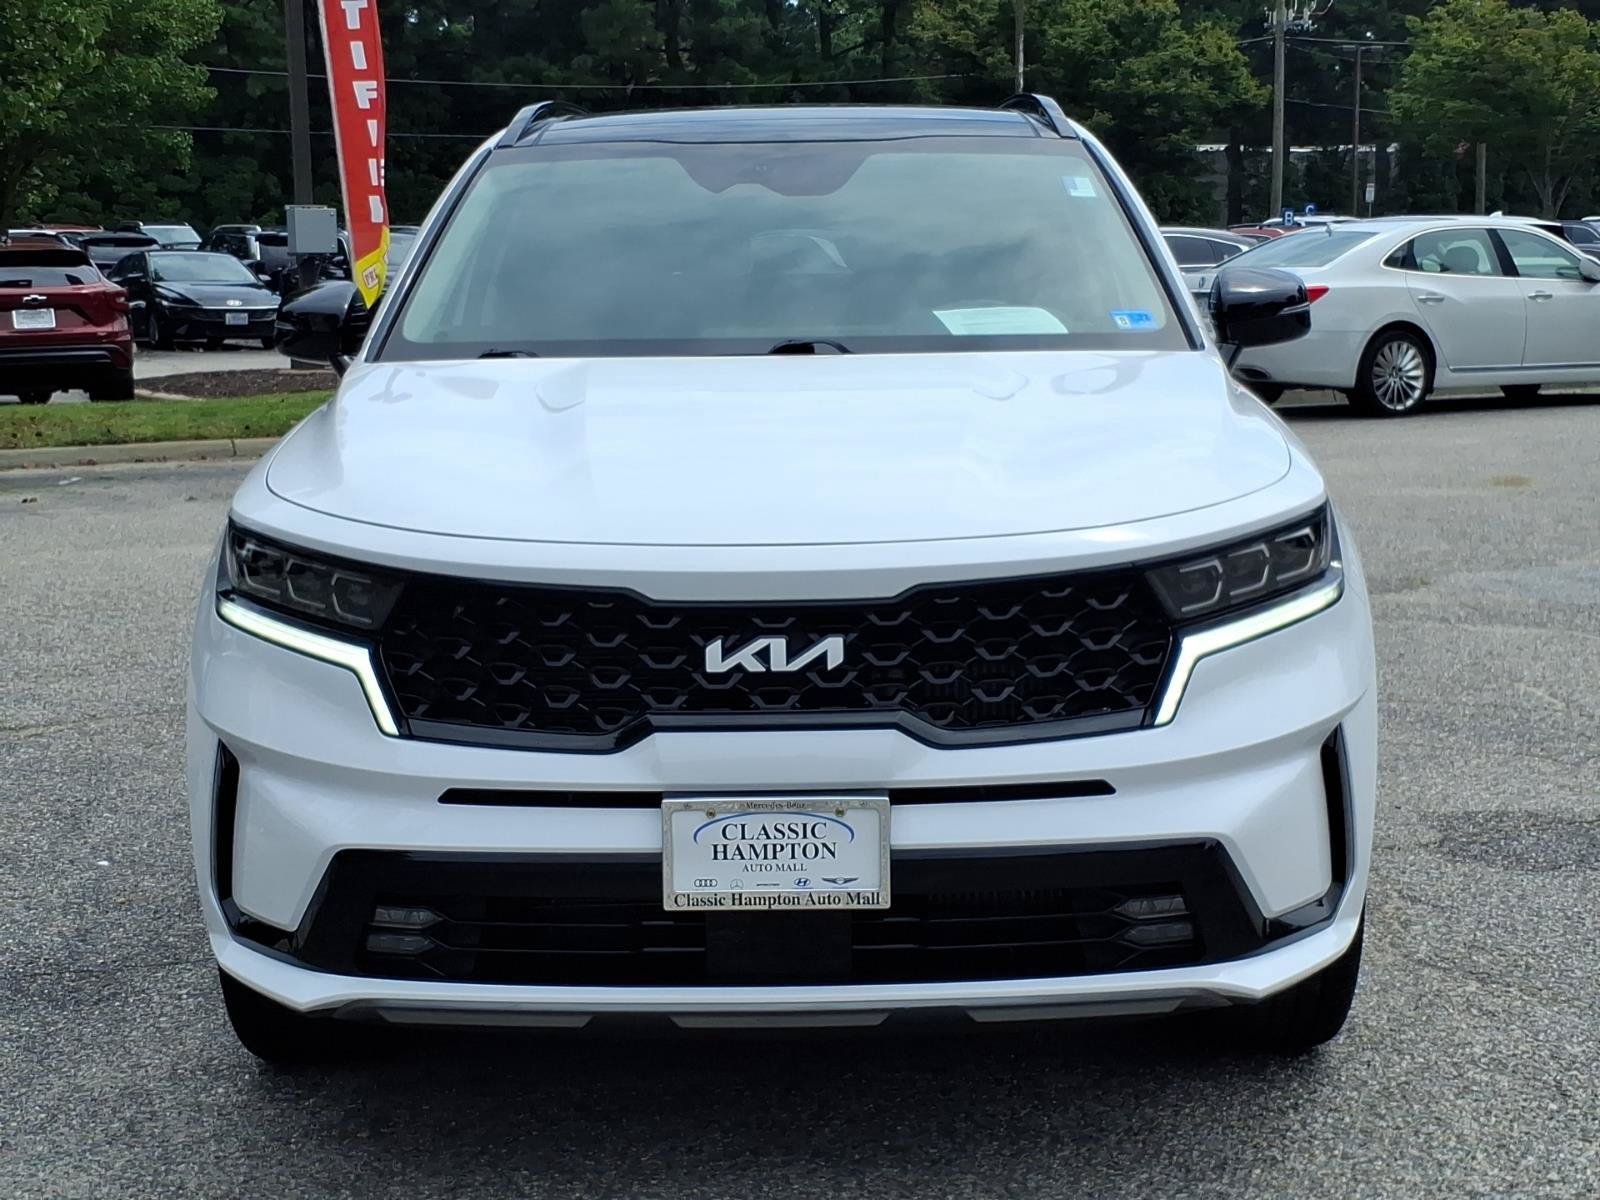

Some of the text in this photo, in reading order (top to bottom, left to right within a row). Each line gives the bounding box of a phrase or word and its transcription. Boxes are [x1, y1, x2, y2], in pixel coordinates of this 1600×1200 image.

[1284, 211, 1294, 226] B
[705, 637, 844, 673] KIA
[721, 822, 828, 841] CLASSIC
[711, 842, 838, 861] HAMPTON
[742, 863, 808, 873] AUTO MALL
[674, 891, 881, 909] Classic Hampton Auto Mall
